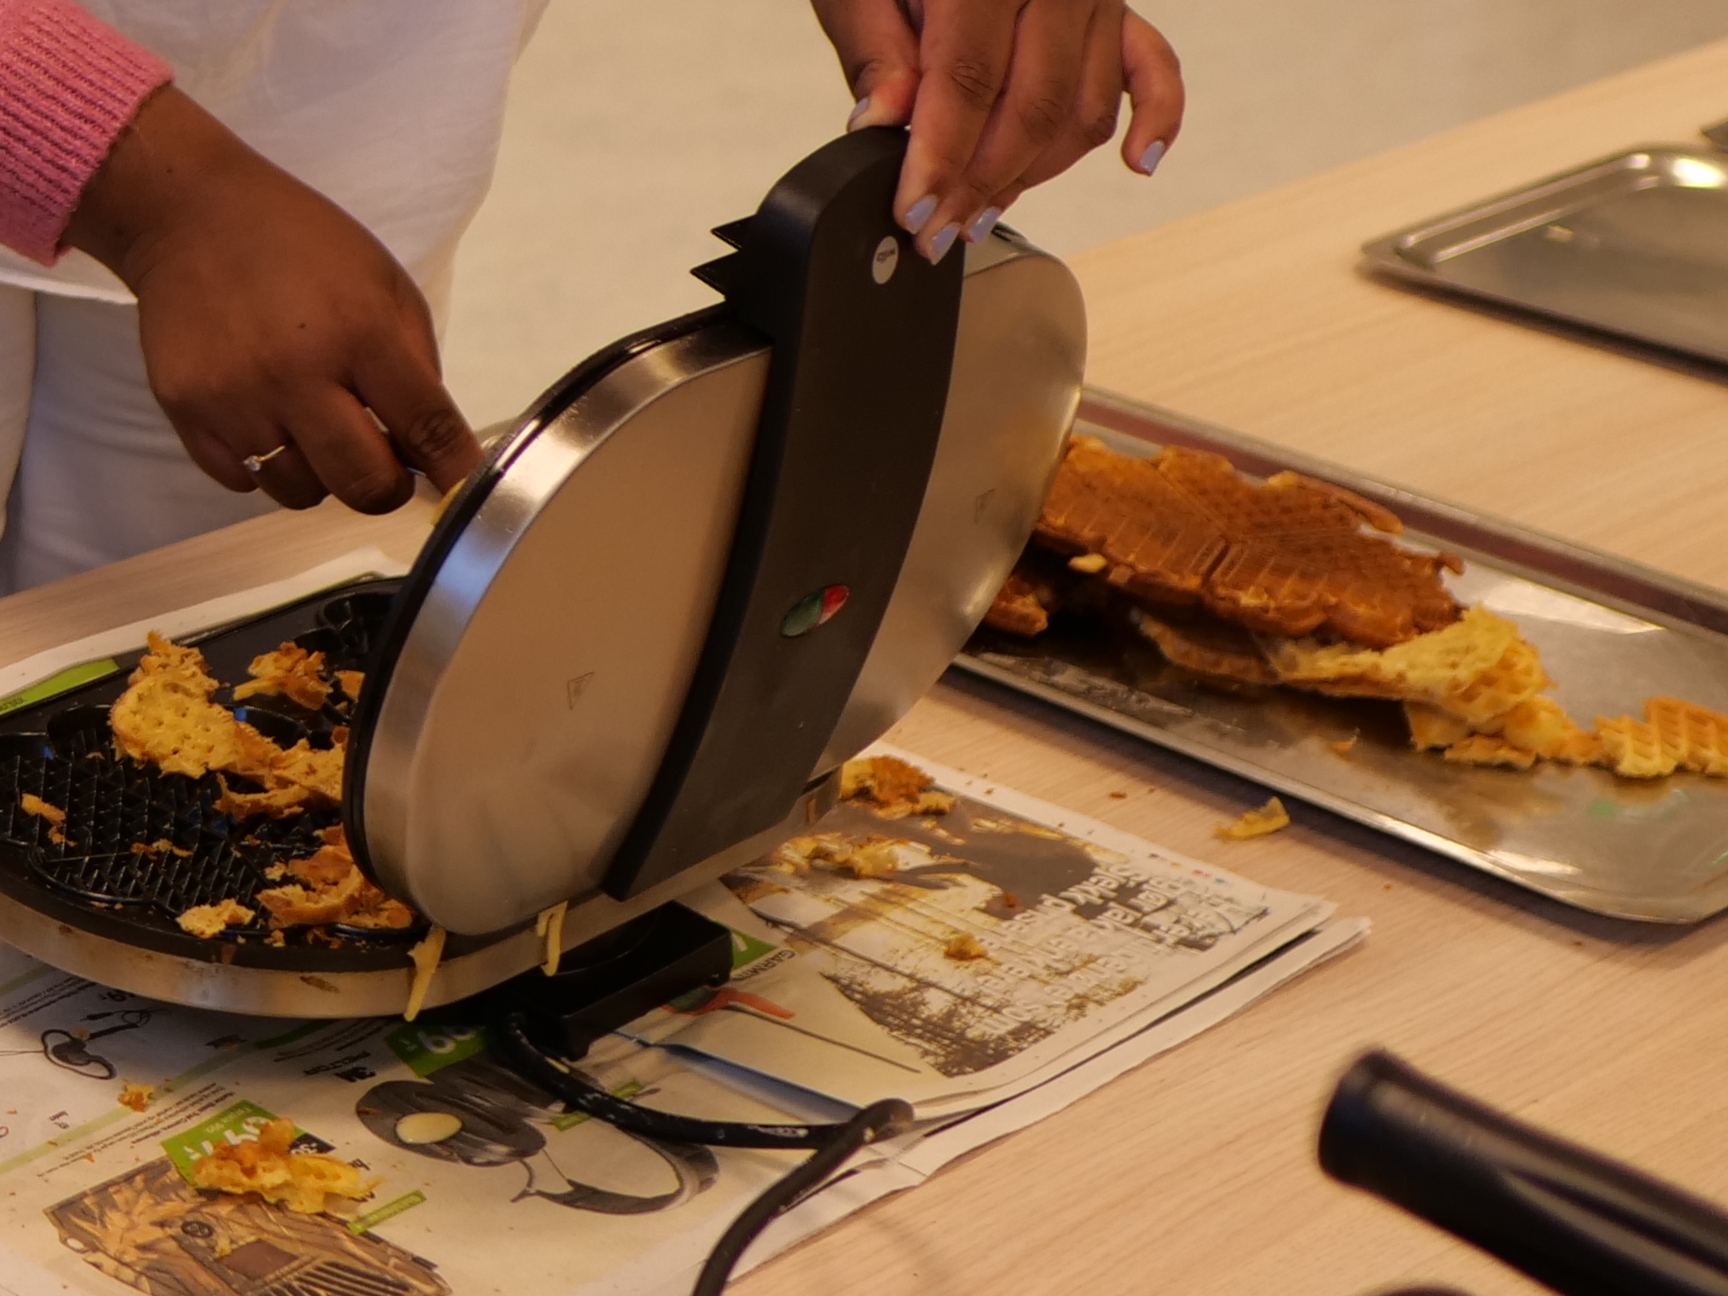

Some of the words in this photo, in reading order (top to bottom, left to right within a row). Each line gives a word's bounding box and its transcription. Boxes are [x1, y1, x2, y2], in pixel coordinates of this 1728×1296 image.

[1056, 865, 1152, 906] Sjekk
[1126, 876, 1189, 912] gjør
[969, 893, 1075, 951] prisene
[972, 997, 1045, 1037] som
[334, 1066, 377, 1083] 3M
